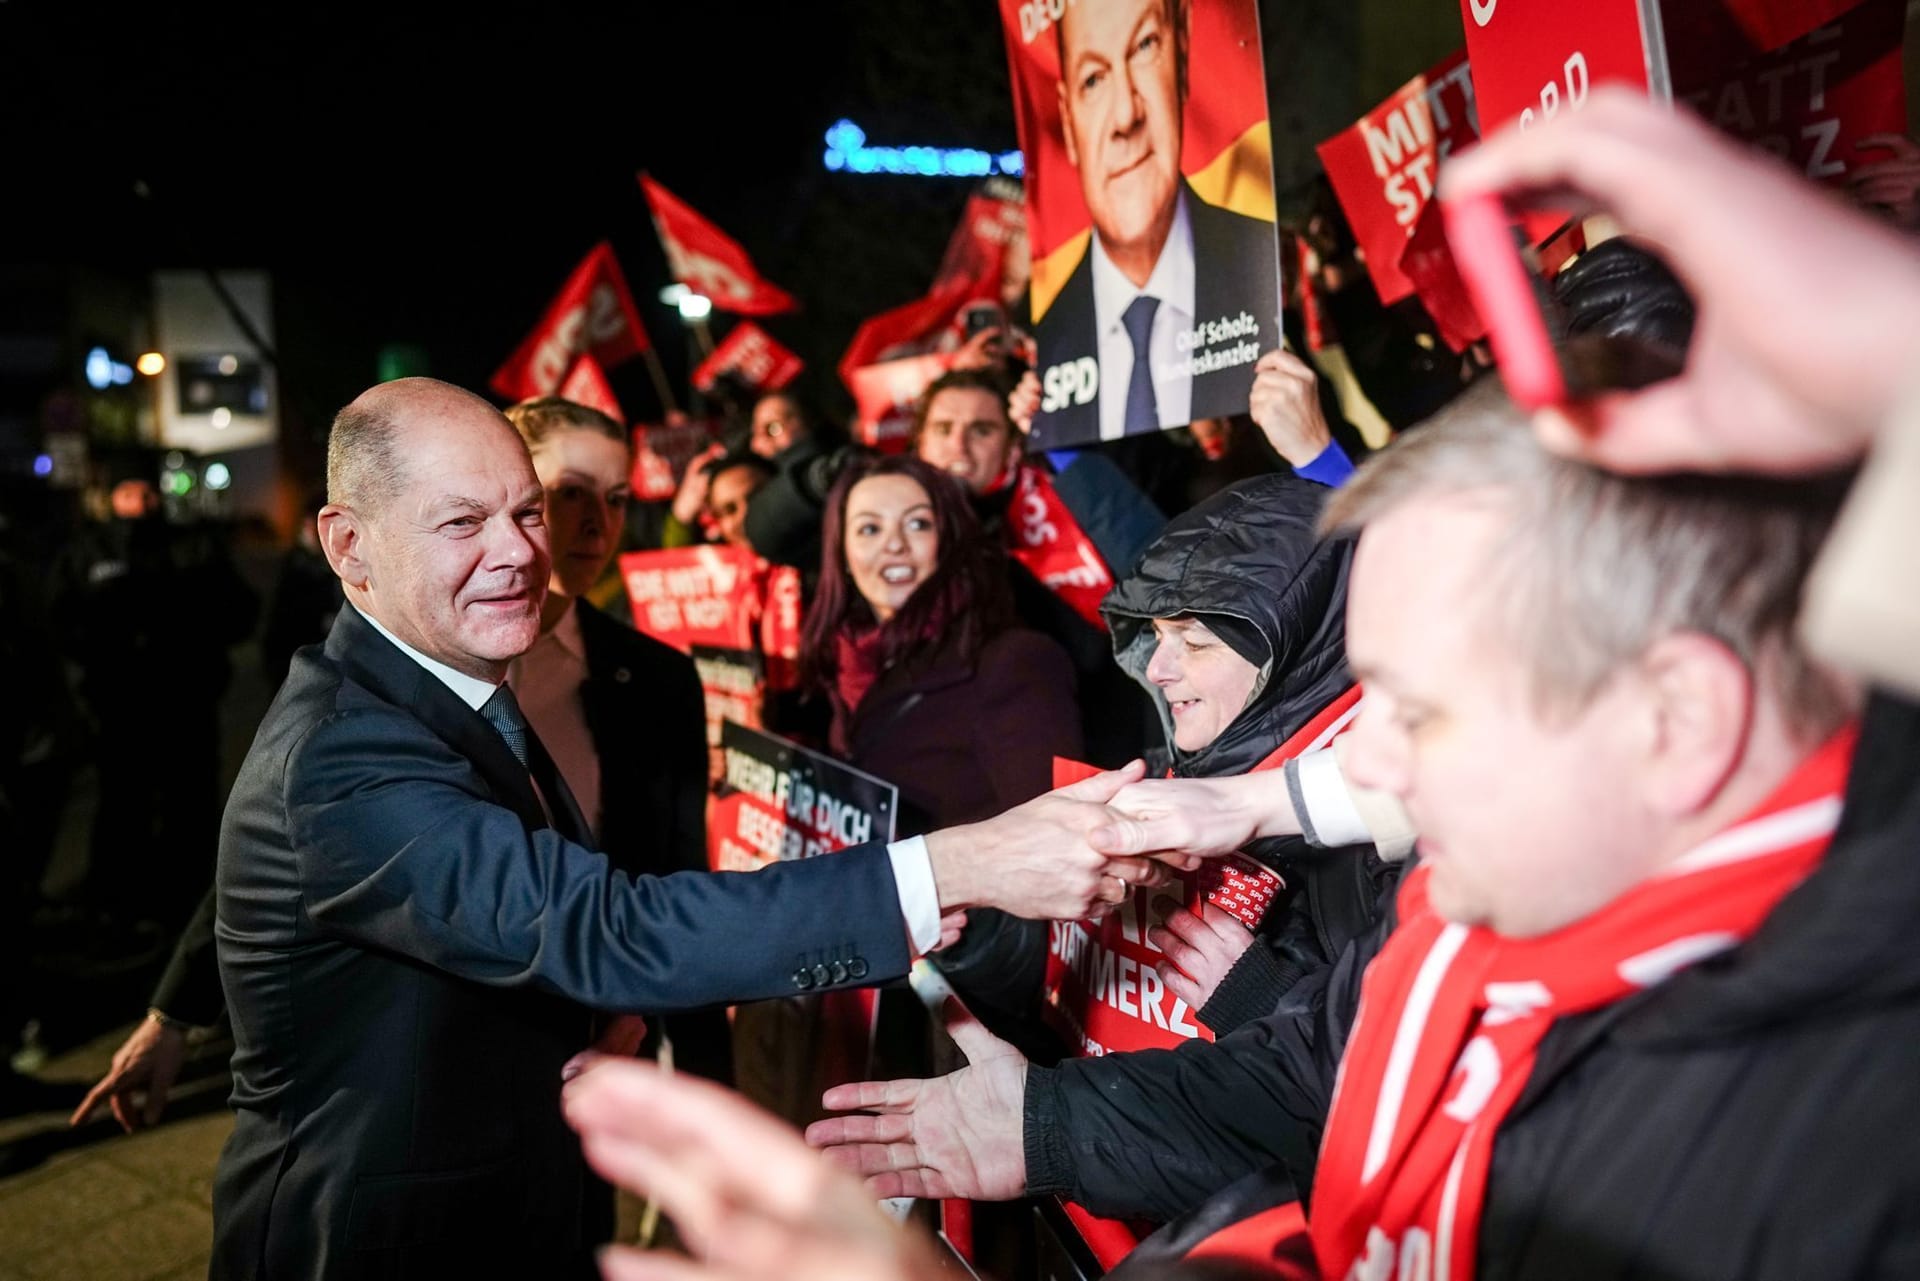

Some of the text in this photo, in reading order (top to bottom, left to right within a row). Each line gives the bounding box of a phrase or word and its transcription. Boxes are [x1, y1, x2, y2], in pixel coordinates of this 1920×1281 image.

[1176, 311, 1259, 352] Olaf Scholz,
[1041, 356, 1100, 414] SPD
[774, 769, 814, 825] FÜR
[816, 792, 872, 846] DICH
[1243, 875, 1260, 887] SPD
[1258, 872, 1274, 884] SPD
[1228, 879, 1264, 902] SPD SPD
[1234, 893, 1251, 905] SPD
[1220, 897, 1237, 909] SPD
[1240, 907, 1255, 920] SPD
[1088, 941, 1199, 1039] MERZ
